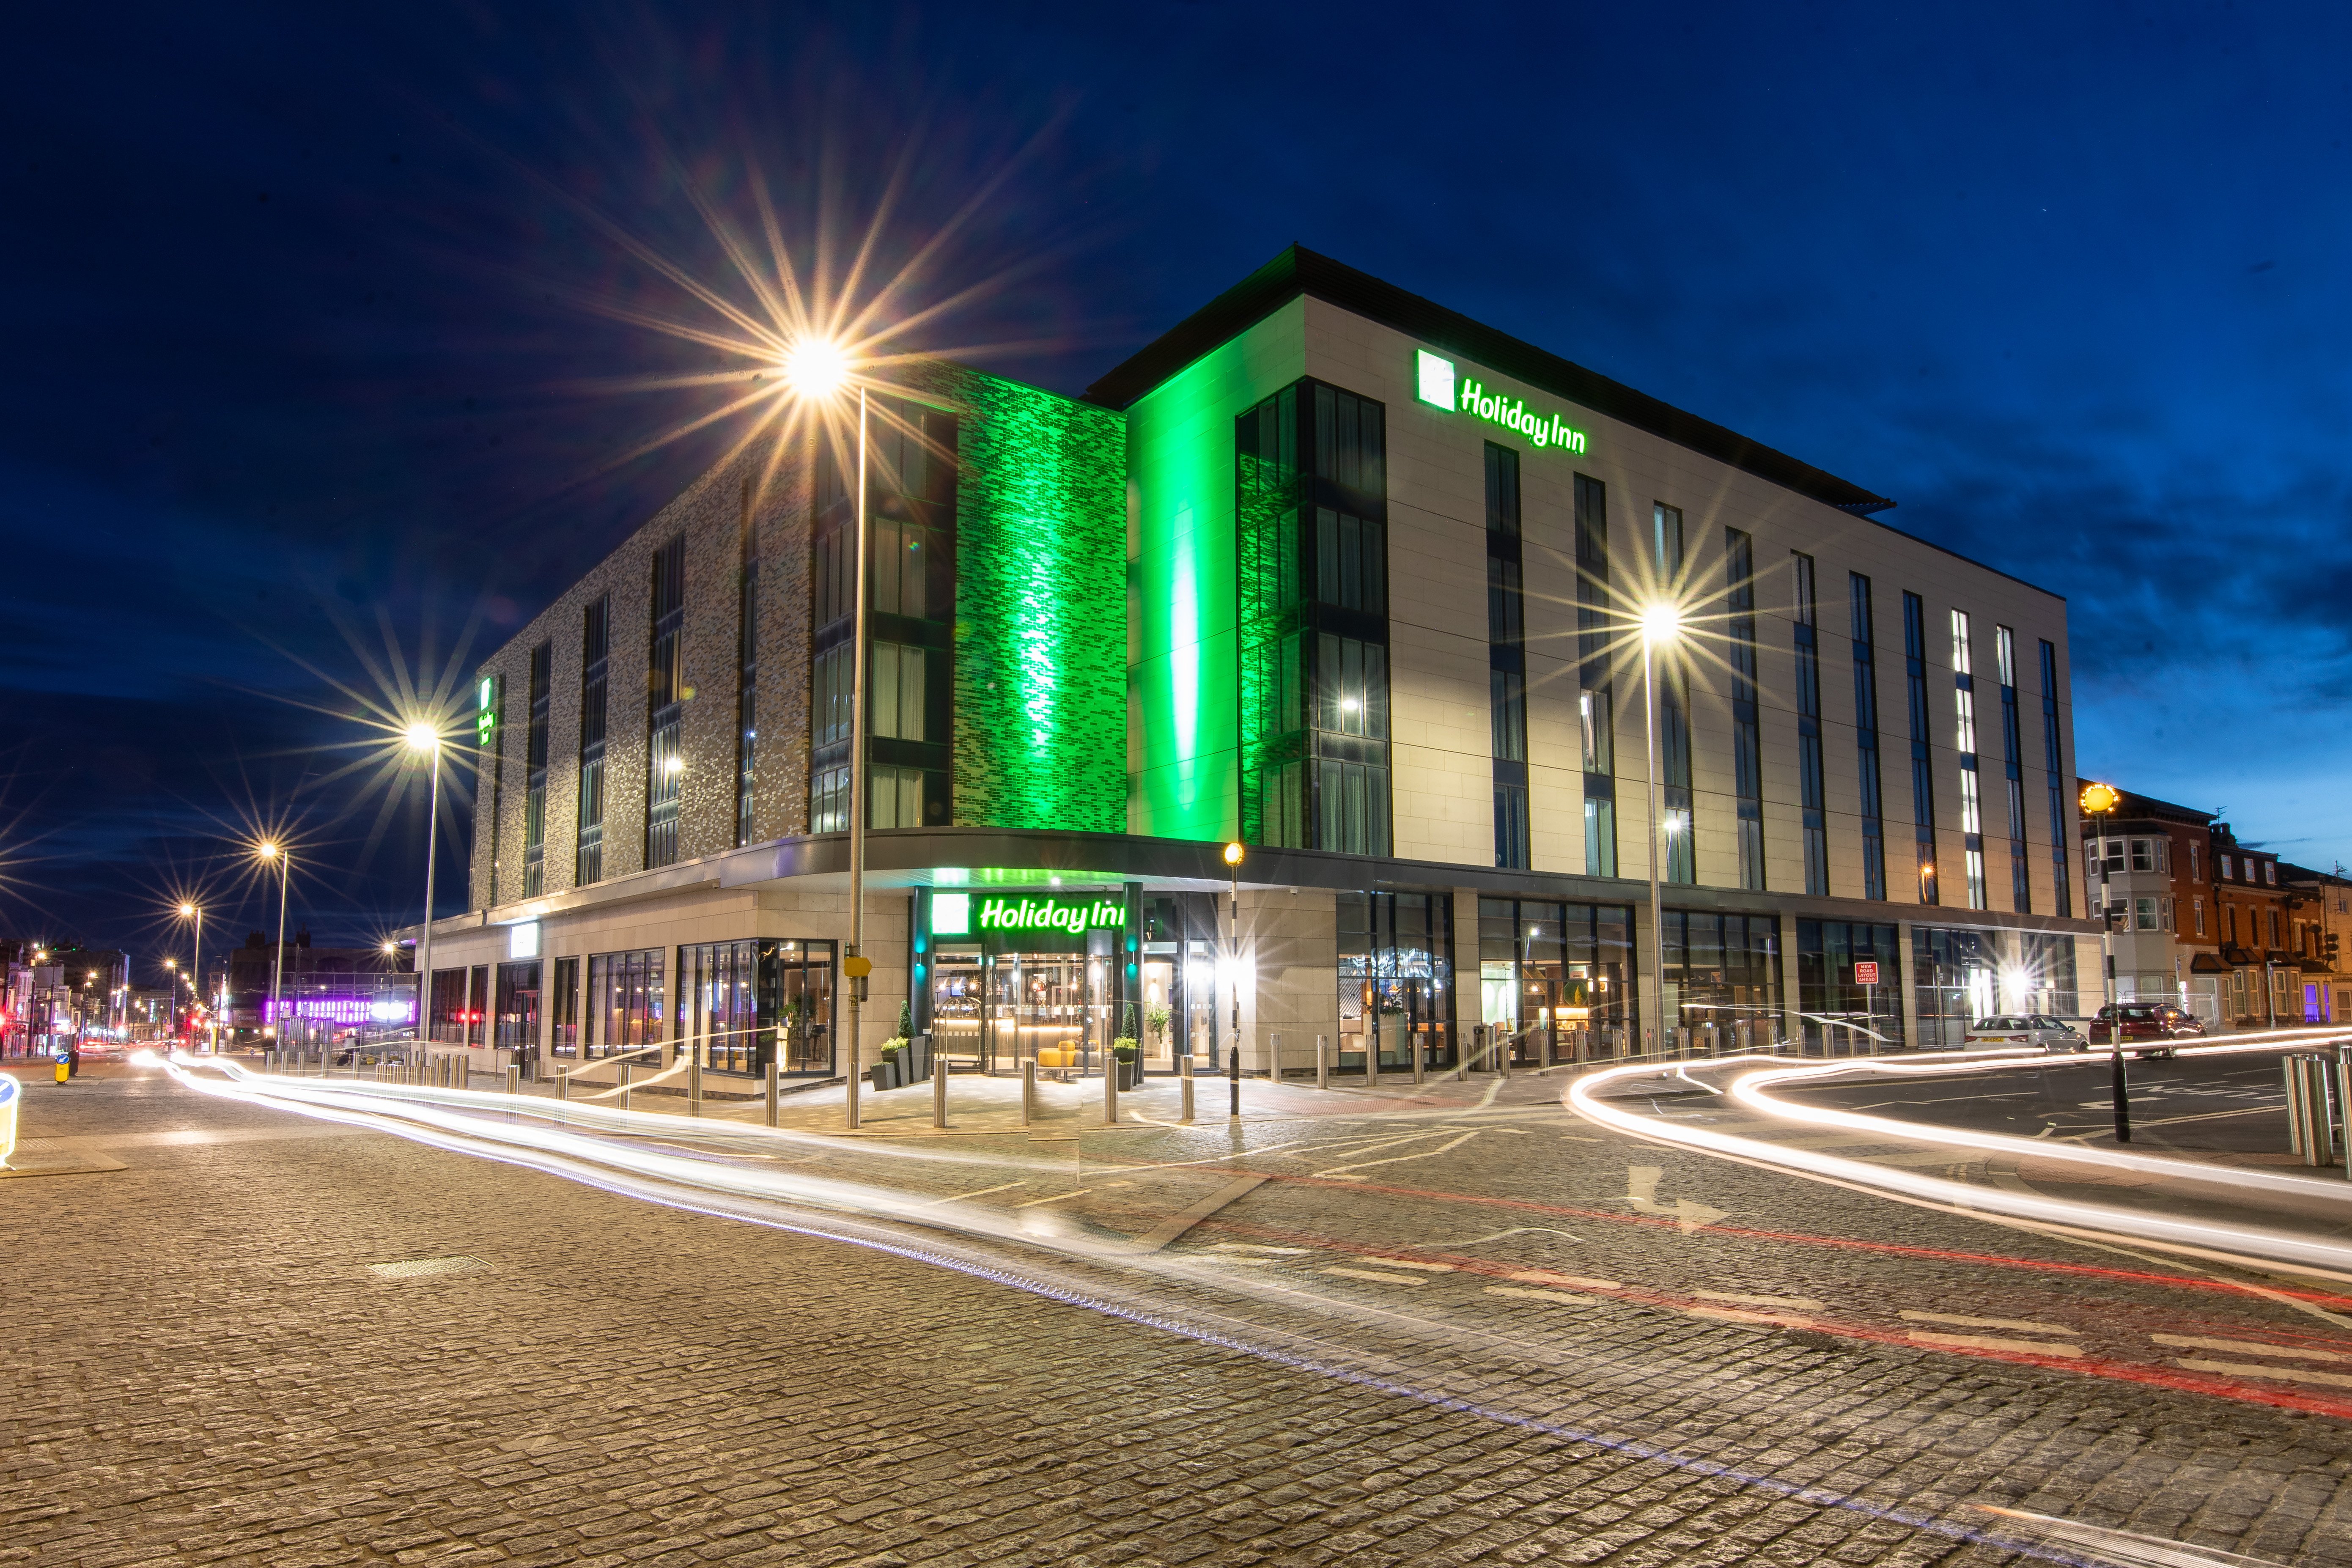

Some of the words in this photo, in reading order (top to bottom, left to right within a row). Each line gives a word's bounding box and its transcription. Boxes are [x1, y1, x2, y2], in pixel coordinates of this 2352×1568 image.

[1461, 379, 1548, 446] Holiday
[1551, 414, 1585, 453] Inn
[980, 900, 1087, 933] Holiday
